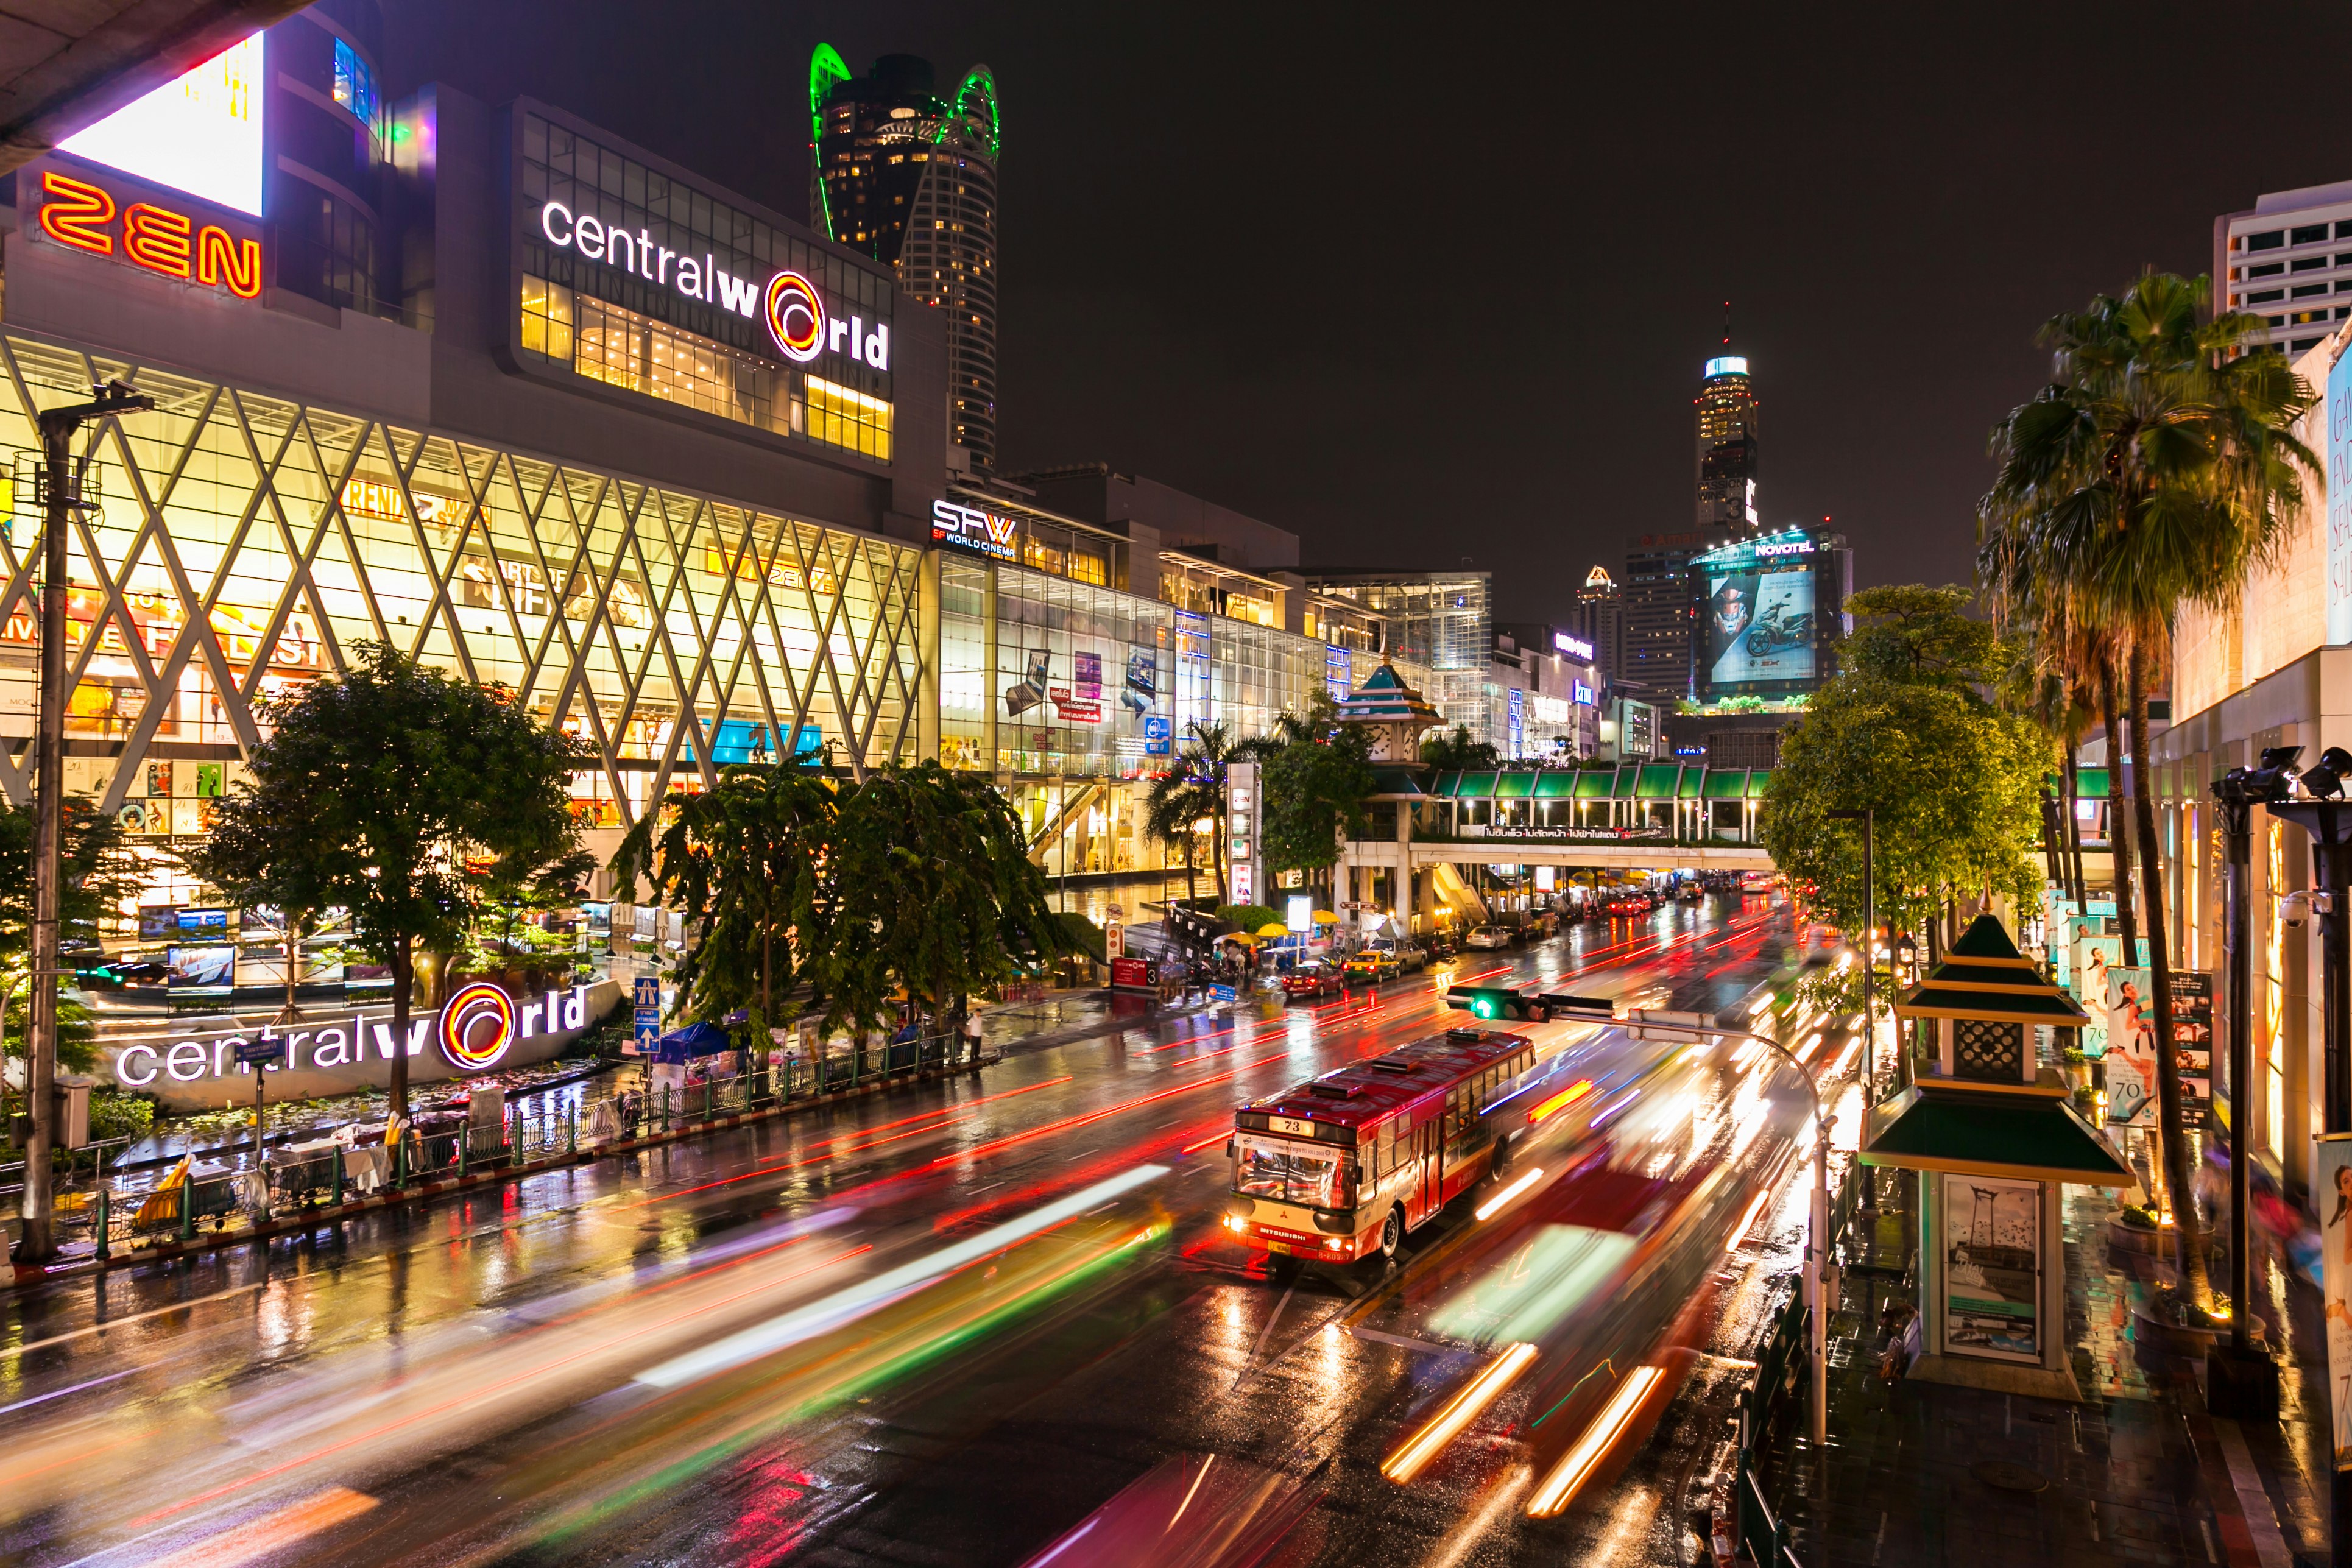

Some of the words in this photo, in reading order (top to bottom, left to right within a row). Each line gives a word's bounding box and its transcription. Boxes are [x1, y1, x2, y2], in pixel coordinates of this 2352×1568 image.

[39, 171, 262, 300] ZEN
[1726, 496, 1743, 520] 3
[933, 500, 1016, 544] SFW
[933, 529, 945, 539] SF
[947, 533, 980, 548] WORLD
[981, 542, 1015, 557] CINEMA
[1756, 540, 1815, 557] NOVOTEL
[1148, 969, 1156, 983] 3
[2116, 1082, 2140, 1100] 70
[1285, 1120, 1300, 1132] 73
[1260, 1227, 1306, 1241] MITSUBISHI
